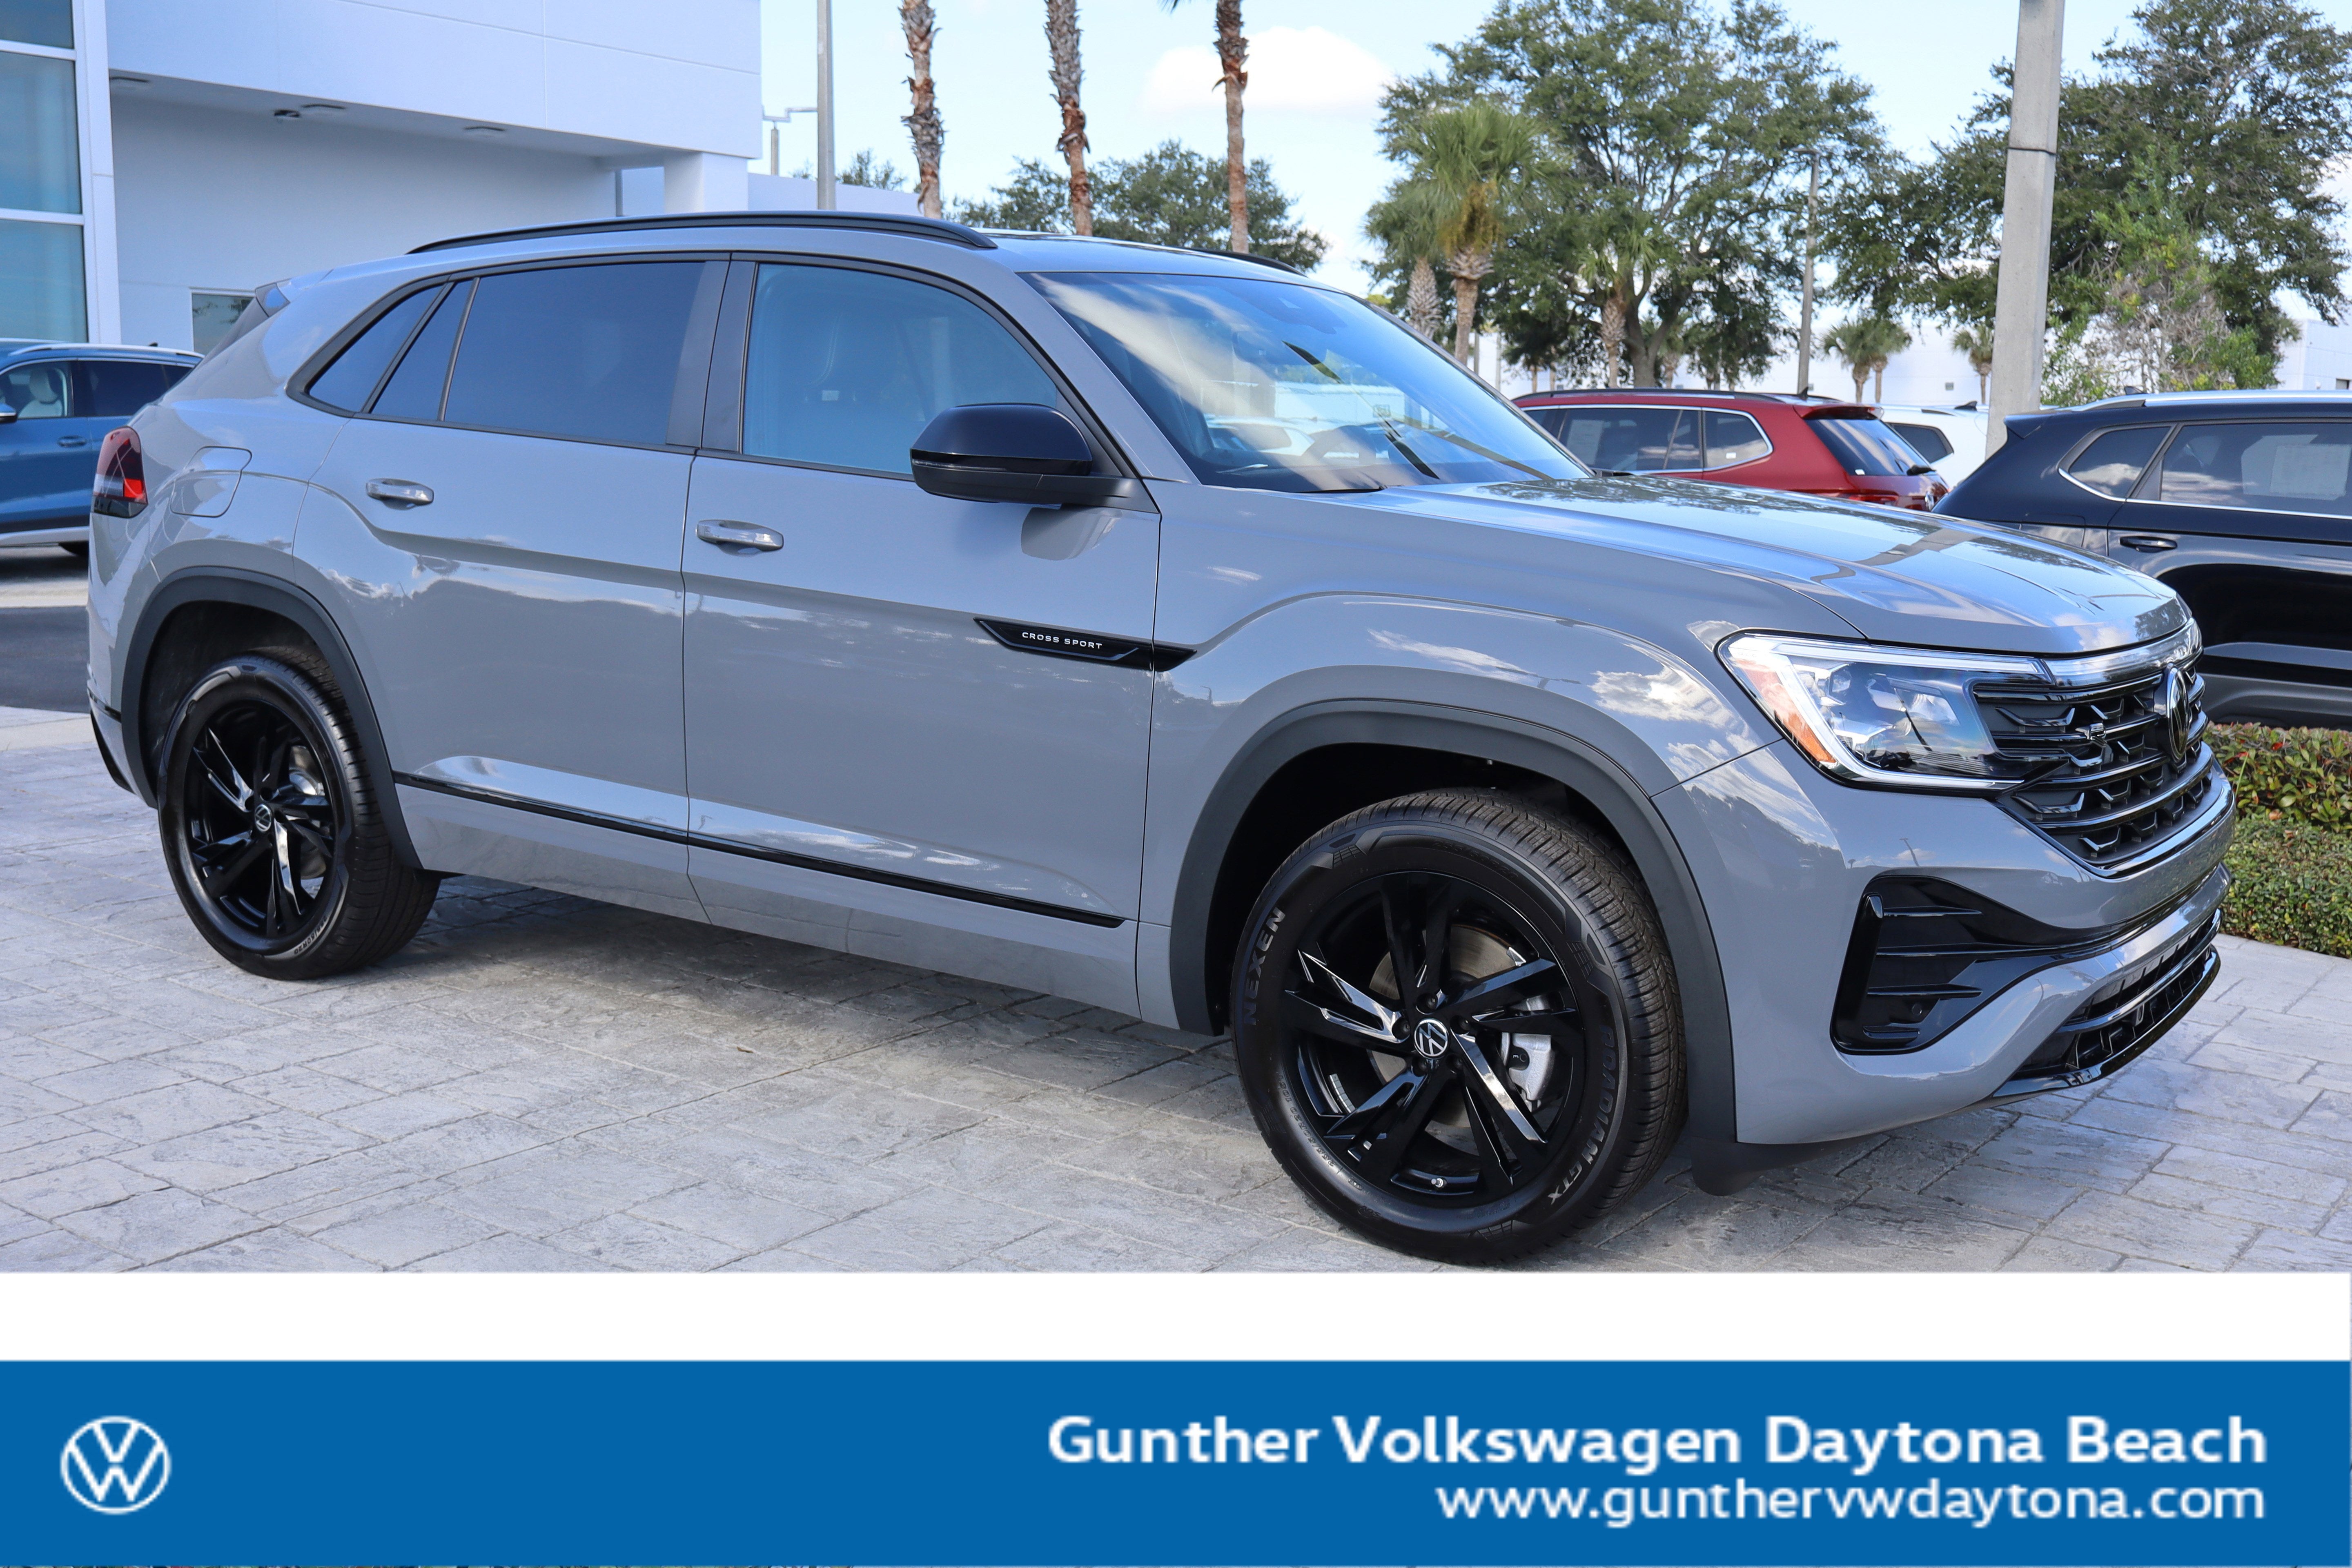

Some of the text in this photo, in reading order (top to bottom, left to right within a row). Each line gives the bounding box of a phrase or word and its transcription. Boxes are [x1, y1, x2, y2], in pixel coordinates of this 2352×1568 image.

[1022, 632, 1102, 649] CROSS SPORT
[1244, 907, 1285, 1026] NEXEN
[1548, 1025, 1616, 1205] ROADIAN GTX
